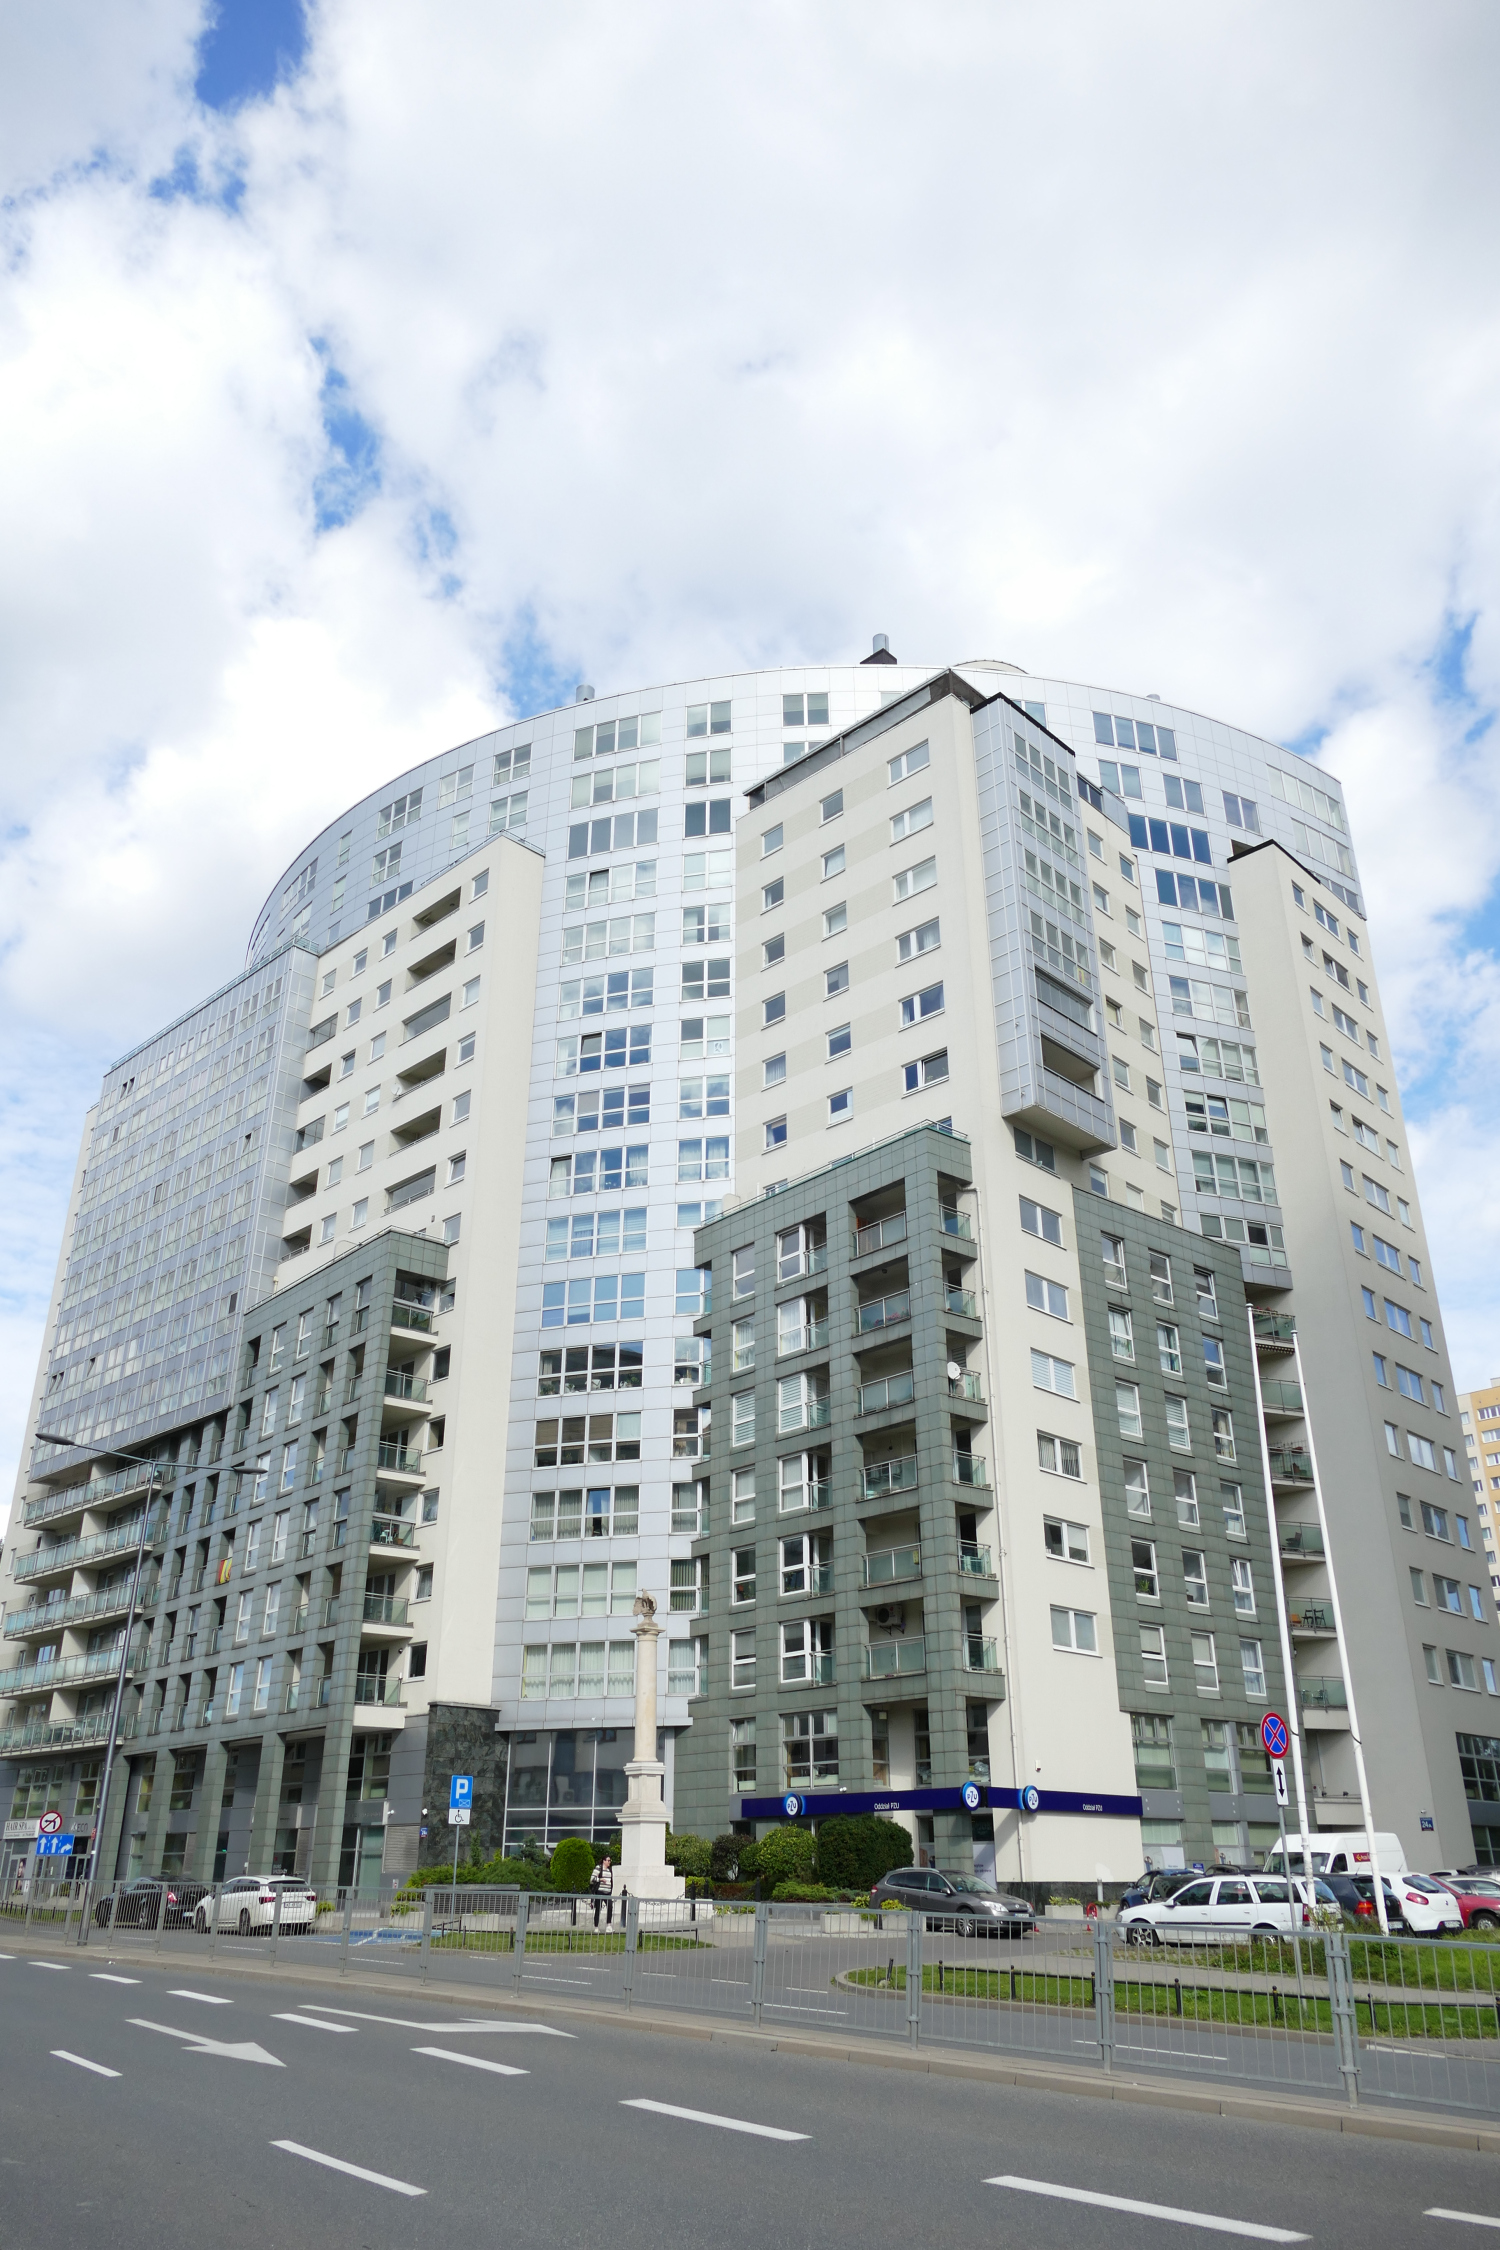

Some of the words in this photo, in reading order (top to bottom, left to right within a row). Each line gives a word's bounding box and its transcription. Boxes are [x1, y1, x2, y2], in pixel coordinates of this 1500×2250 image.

[455, 1778, 469, 1799] P
[967, 1790, 978, 1803] PZU
[1028, 1793, 1038, 1806] PZU
[787, 1800, 797, 1812] PZU
[890, 1802, 900, 1810] PZU
